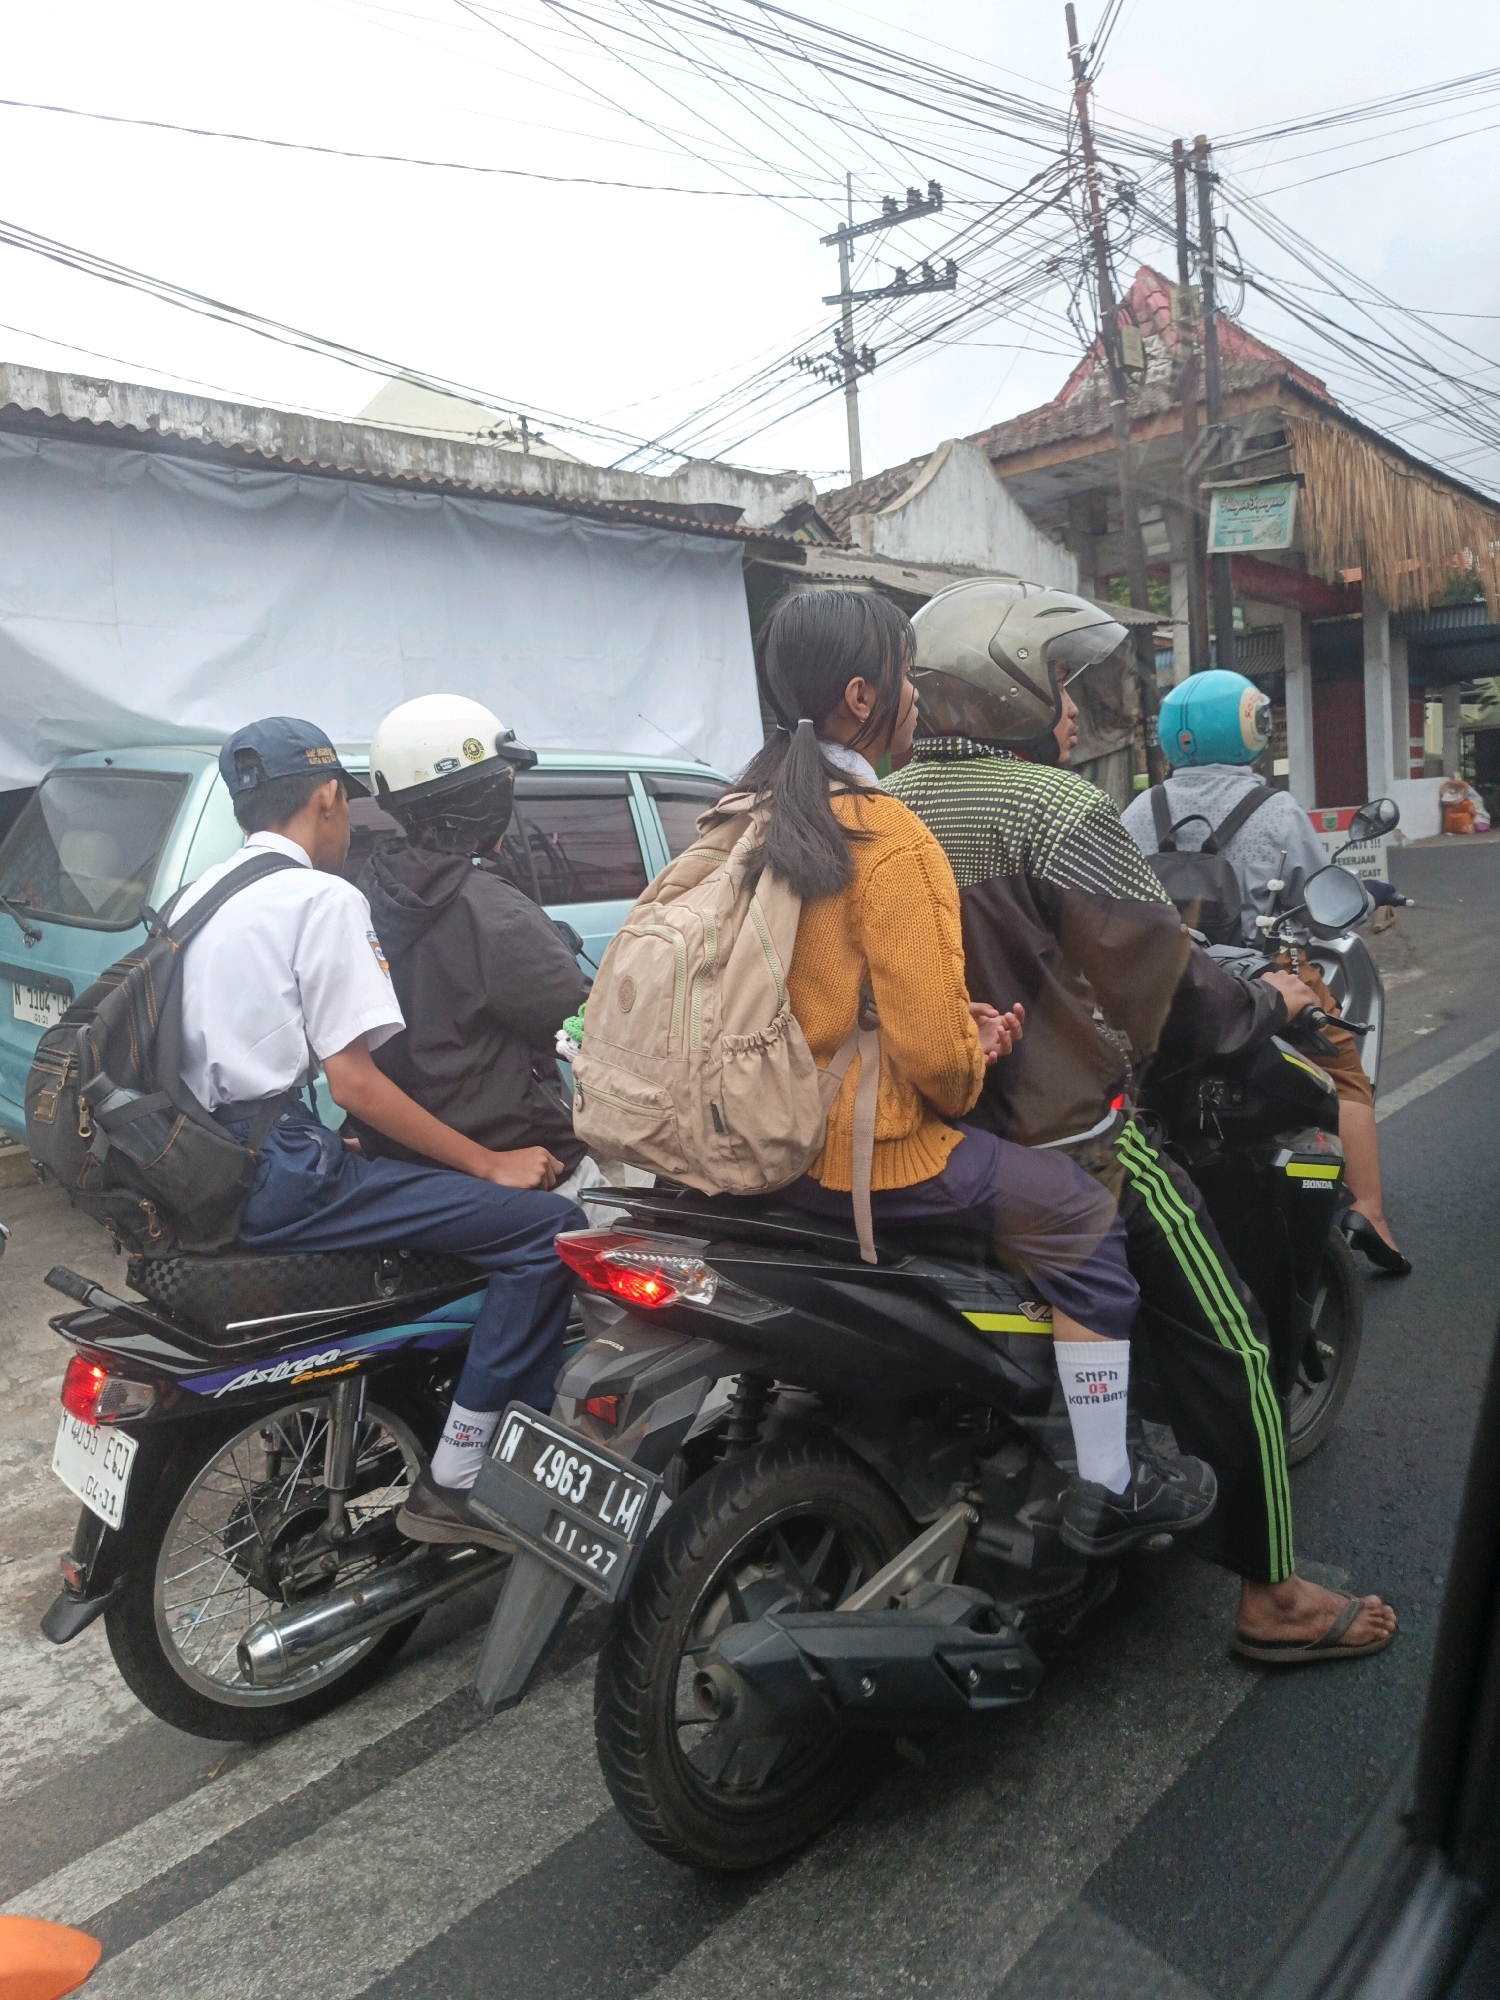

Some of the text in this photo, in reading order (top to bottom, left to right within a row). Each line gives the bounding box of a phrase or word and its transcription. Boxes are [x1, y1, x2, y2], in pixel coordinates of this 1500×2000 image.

[1337, 855, 1376, 866] EKERJAAN
[1302, 1180, 1333, 1189] HONDA
[595, 1339, 624, 1351] HONDA
[213, 1348, 341, 1398] Astrea
[1075, 1370, 1118, 1383] SMPN
[1089, 1383, 1107, 1394] 03
[1069, 1395, 1100, 1405] KOTA
[452, 1420, 484, 1436] SMPN
[455, 1432, 470, 1441] 03
[501, 1424, 641, 1534] N 4963 LM
